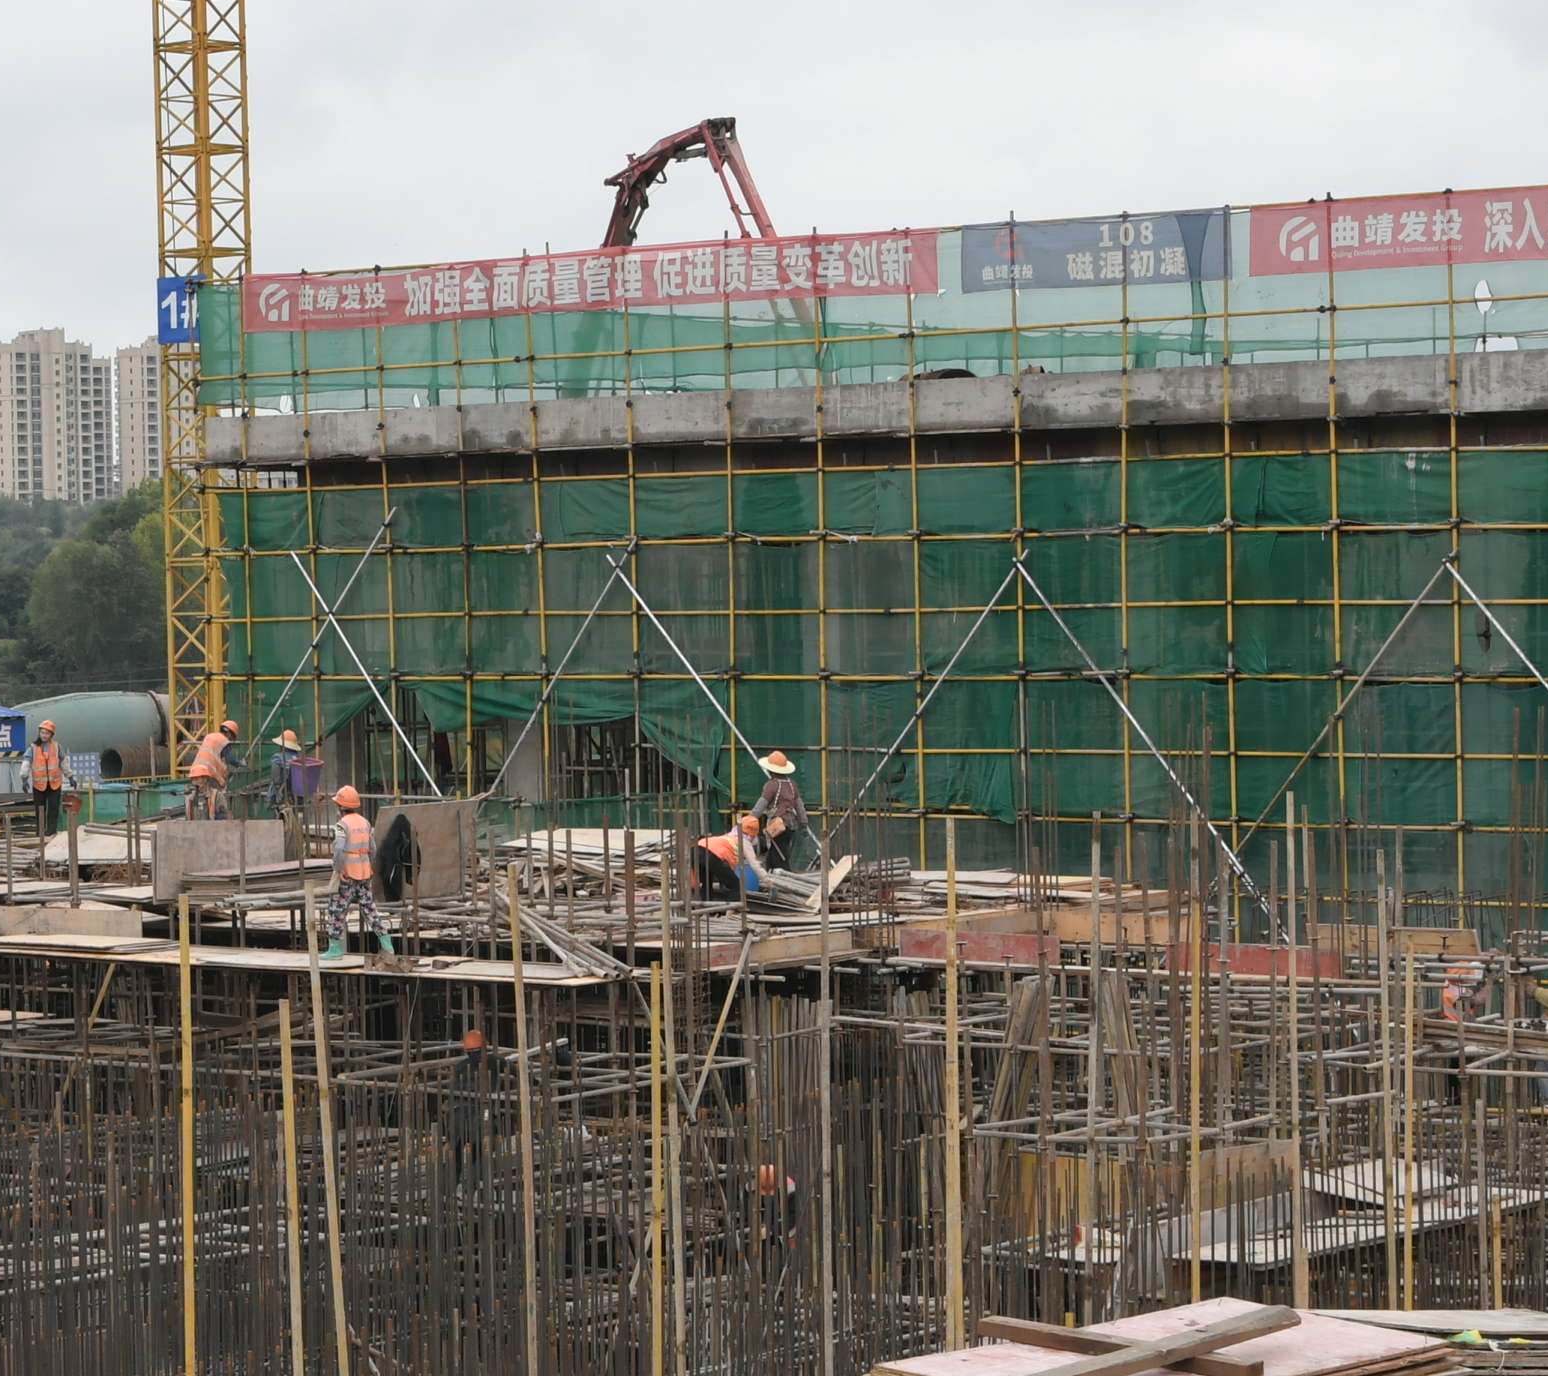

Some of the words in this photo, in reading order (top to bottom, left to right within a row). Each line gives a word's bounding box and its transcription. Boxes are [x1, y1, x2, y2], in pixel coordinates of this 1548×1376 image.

[1098, 222, 1153, 247] 108
[1331, 208, 1462, 248] 曲靖发投
[404, 252, 642, 317] 加强全面质量管理
[654, 238, 913, 299] 促进质量变革创新
[1066, 247, 1187, 280] 磁混初凝
[298, 282, 386, 312] 曲靖发投
